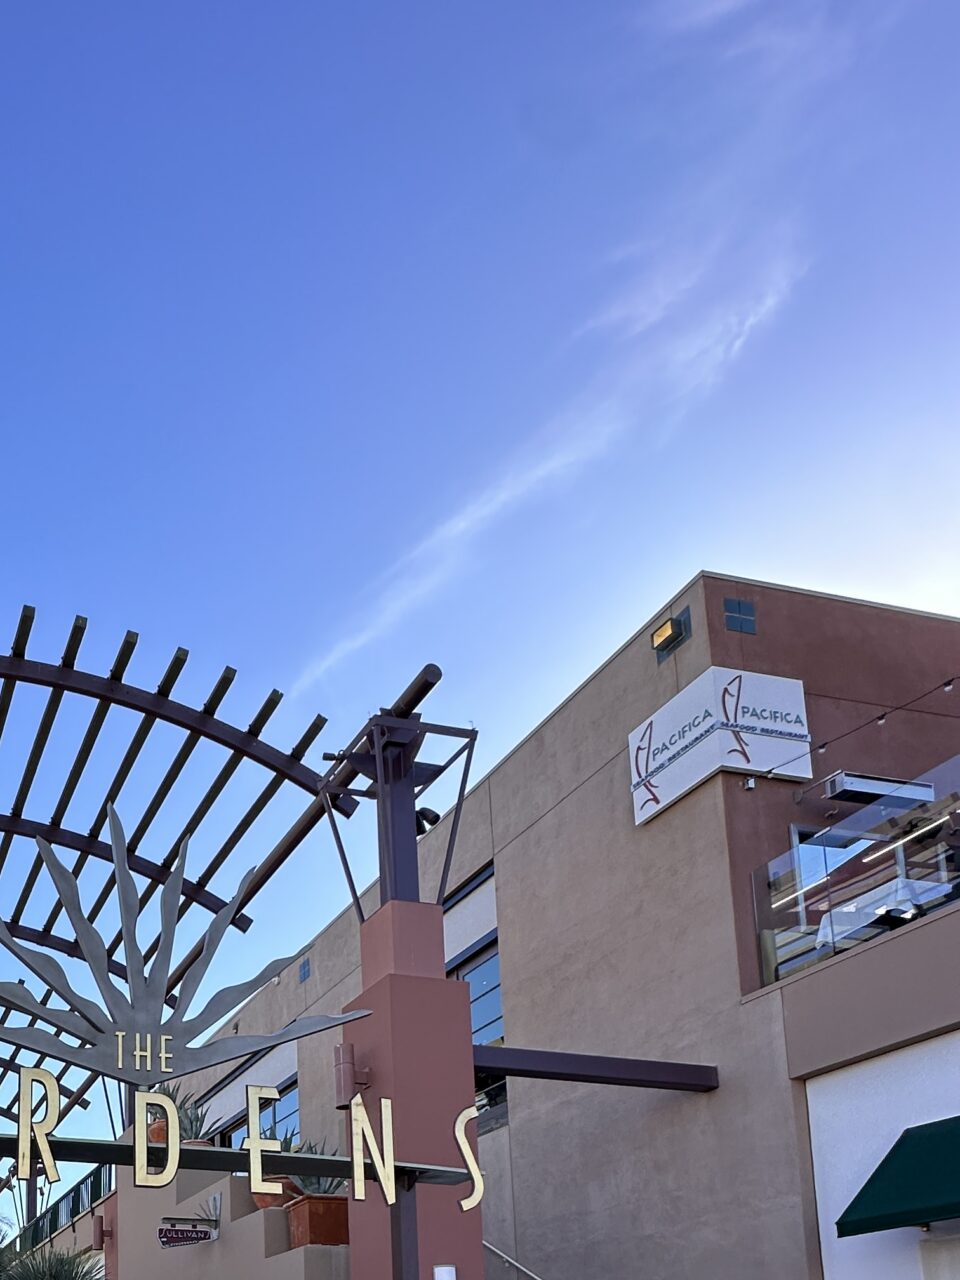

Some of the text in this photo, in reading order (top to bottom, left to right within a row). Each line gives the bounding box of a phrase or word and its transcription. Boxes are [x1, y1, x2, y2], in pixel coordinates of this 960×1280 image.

[651, 708, 714, 762] PACIFICA
[720, 720, 758, 732] SEAFOOD
[741, 705, 805, 727] PACIFICA
[632, 723, 717, 789] SEAFOOD RESTAURANT
[114, 1031, 174, 1074] THE
